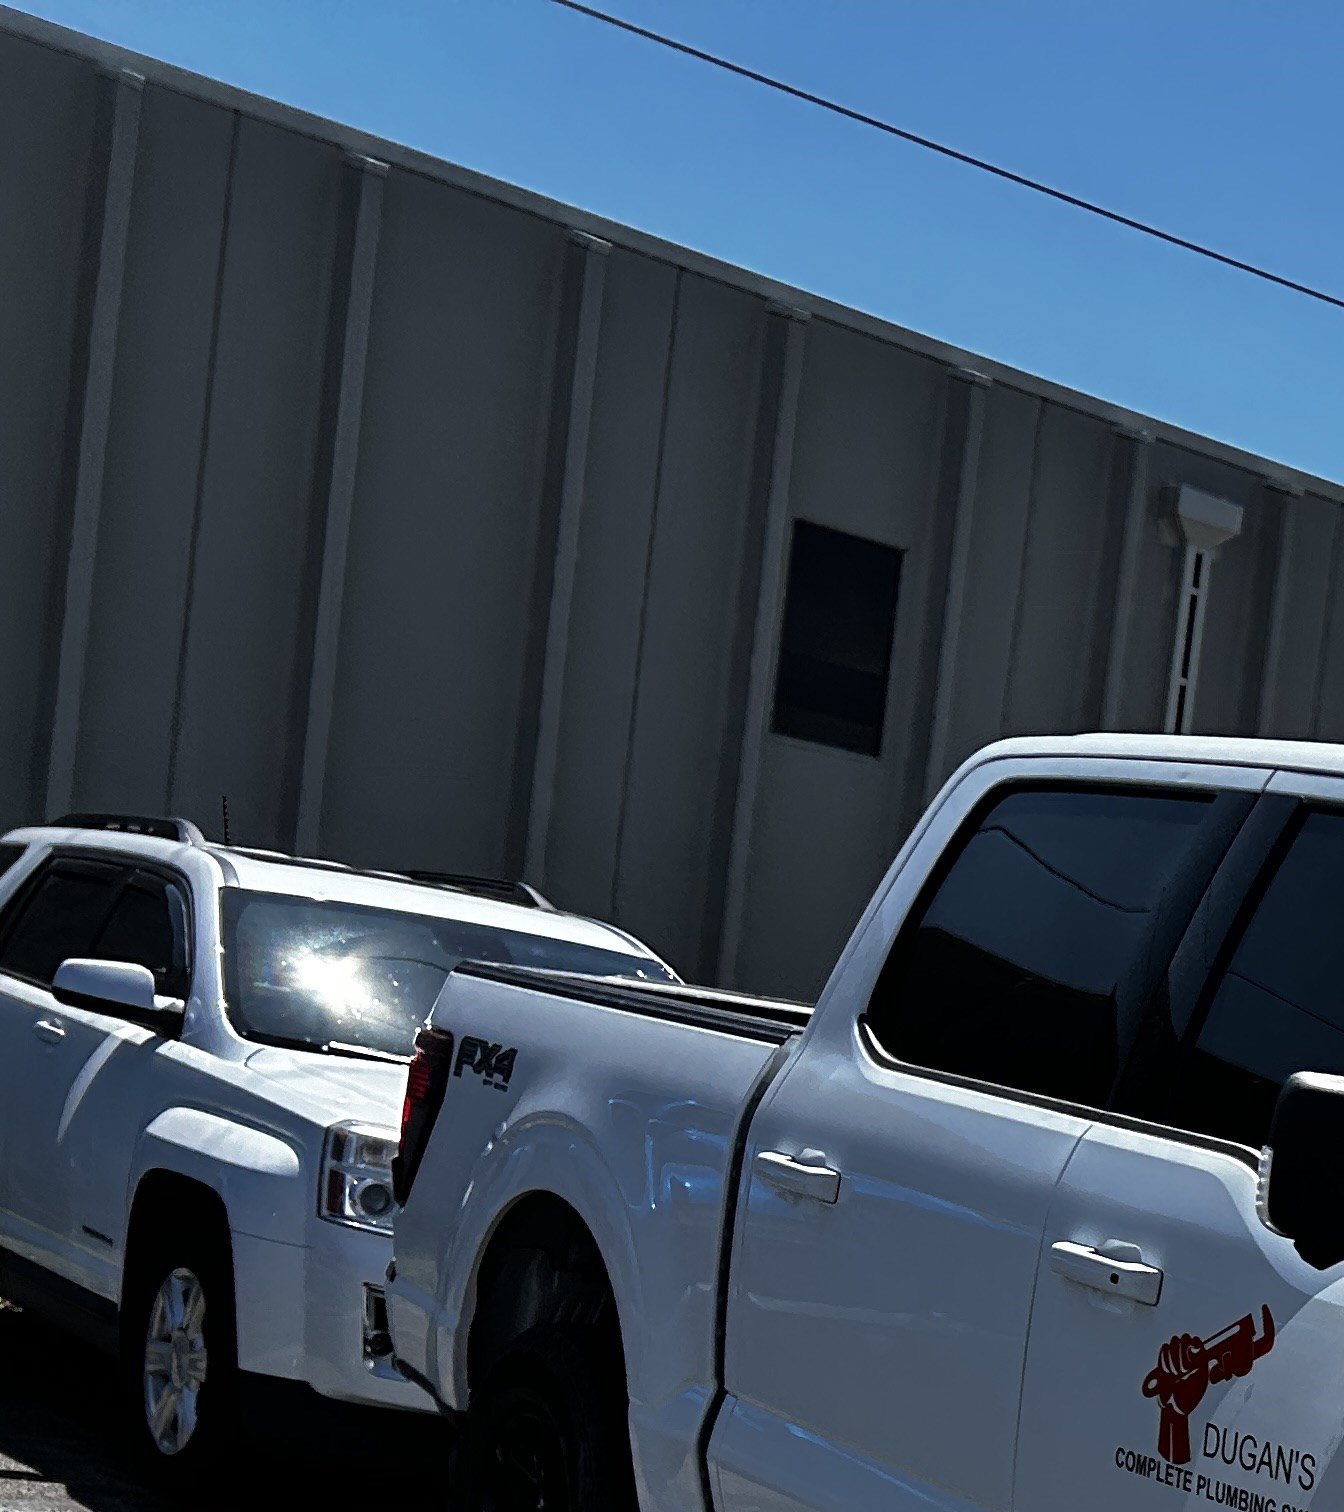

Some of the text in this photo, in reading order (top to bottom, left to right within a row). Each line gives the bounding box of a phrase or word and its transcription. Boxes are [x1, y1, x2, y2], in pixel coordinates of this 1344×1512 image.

[454, 1036, 518, 1083] FX4
[1115, 1447, 1193, 1493] COMPLETE
[1203, 1422, 1316, 1491] DUGAN'S
